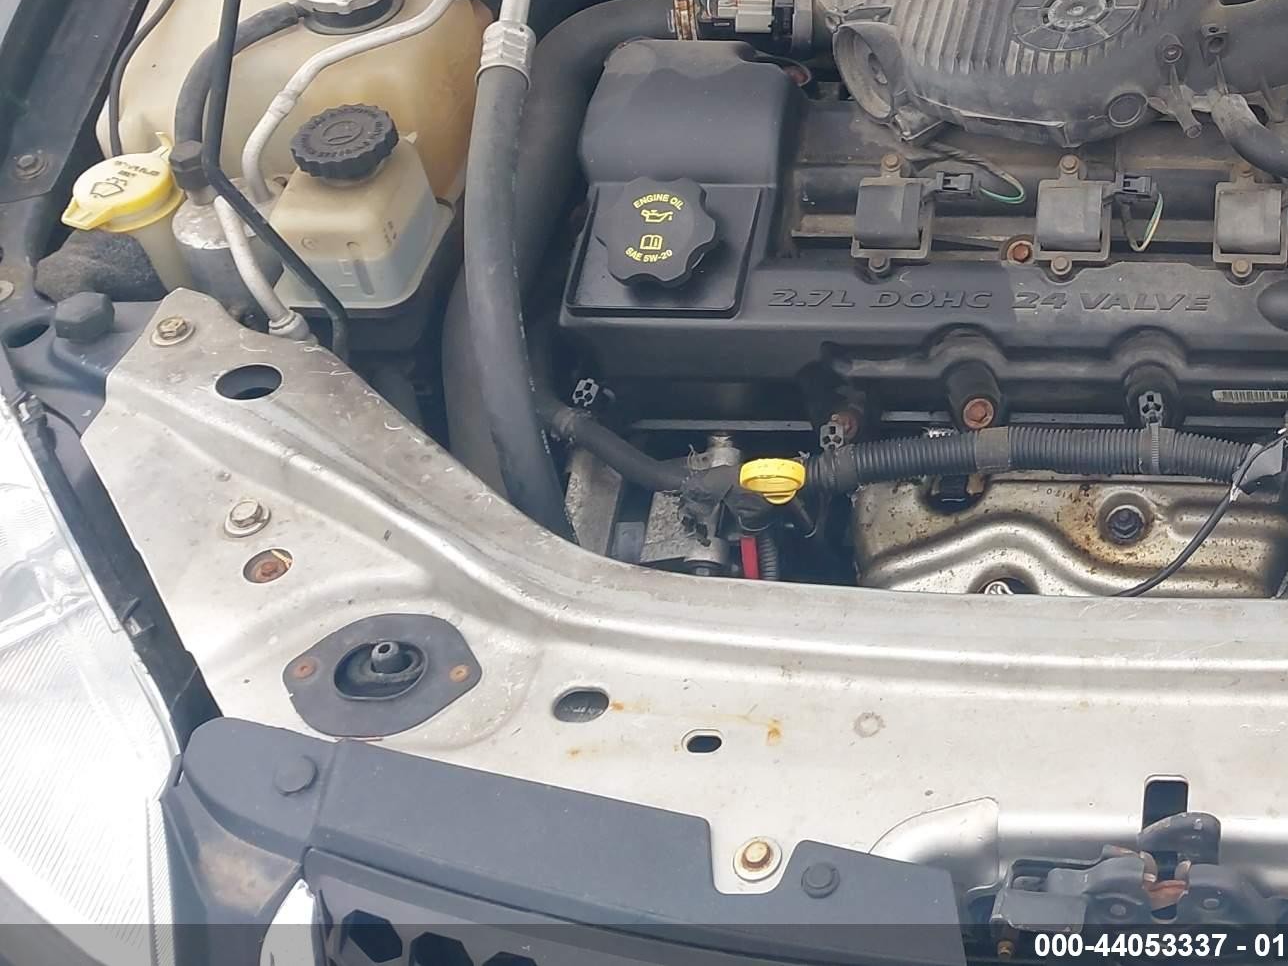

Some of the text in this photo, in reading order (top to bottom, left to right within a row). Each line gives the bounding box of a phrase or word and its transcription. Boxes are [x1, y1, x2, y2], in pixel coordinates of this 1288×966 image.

[633, 194, 684, 211] ENGINE OIL
[625, 247, 673, 263] SAE 5W-20
[767, 288, 1212, 313] 2.7L DOHC 24 VALVE
